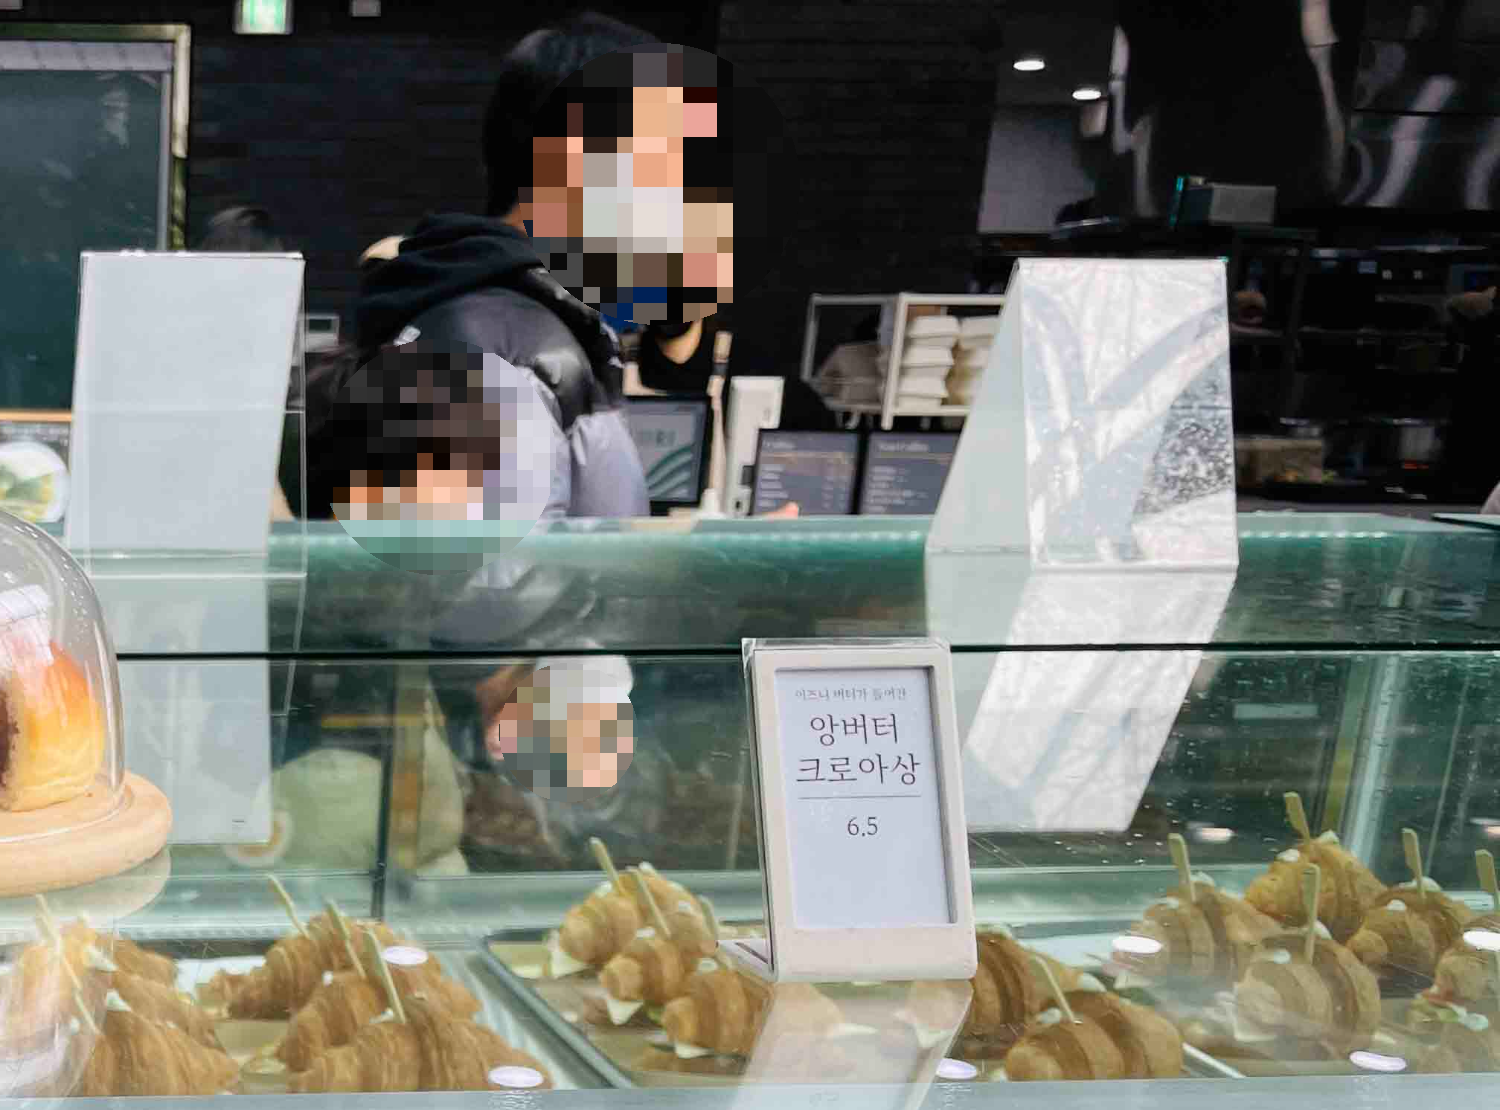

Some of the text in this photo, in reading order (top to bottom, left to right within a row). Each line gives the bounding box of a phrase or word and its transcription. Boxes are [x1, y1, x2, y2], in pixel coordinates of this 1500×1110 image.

[809, 713, 899, 747] 앙버터
[795, 752, 922, 786] 크로아상
[846, 815, 879, 838] 6.5
